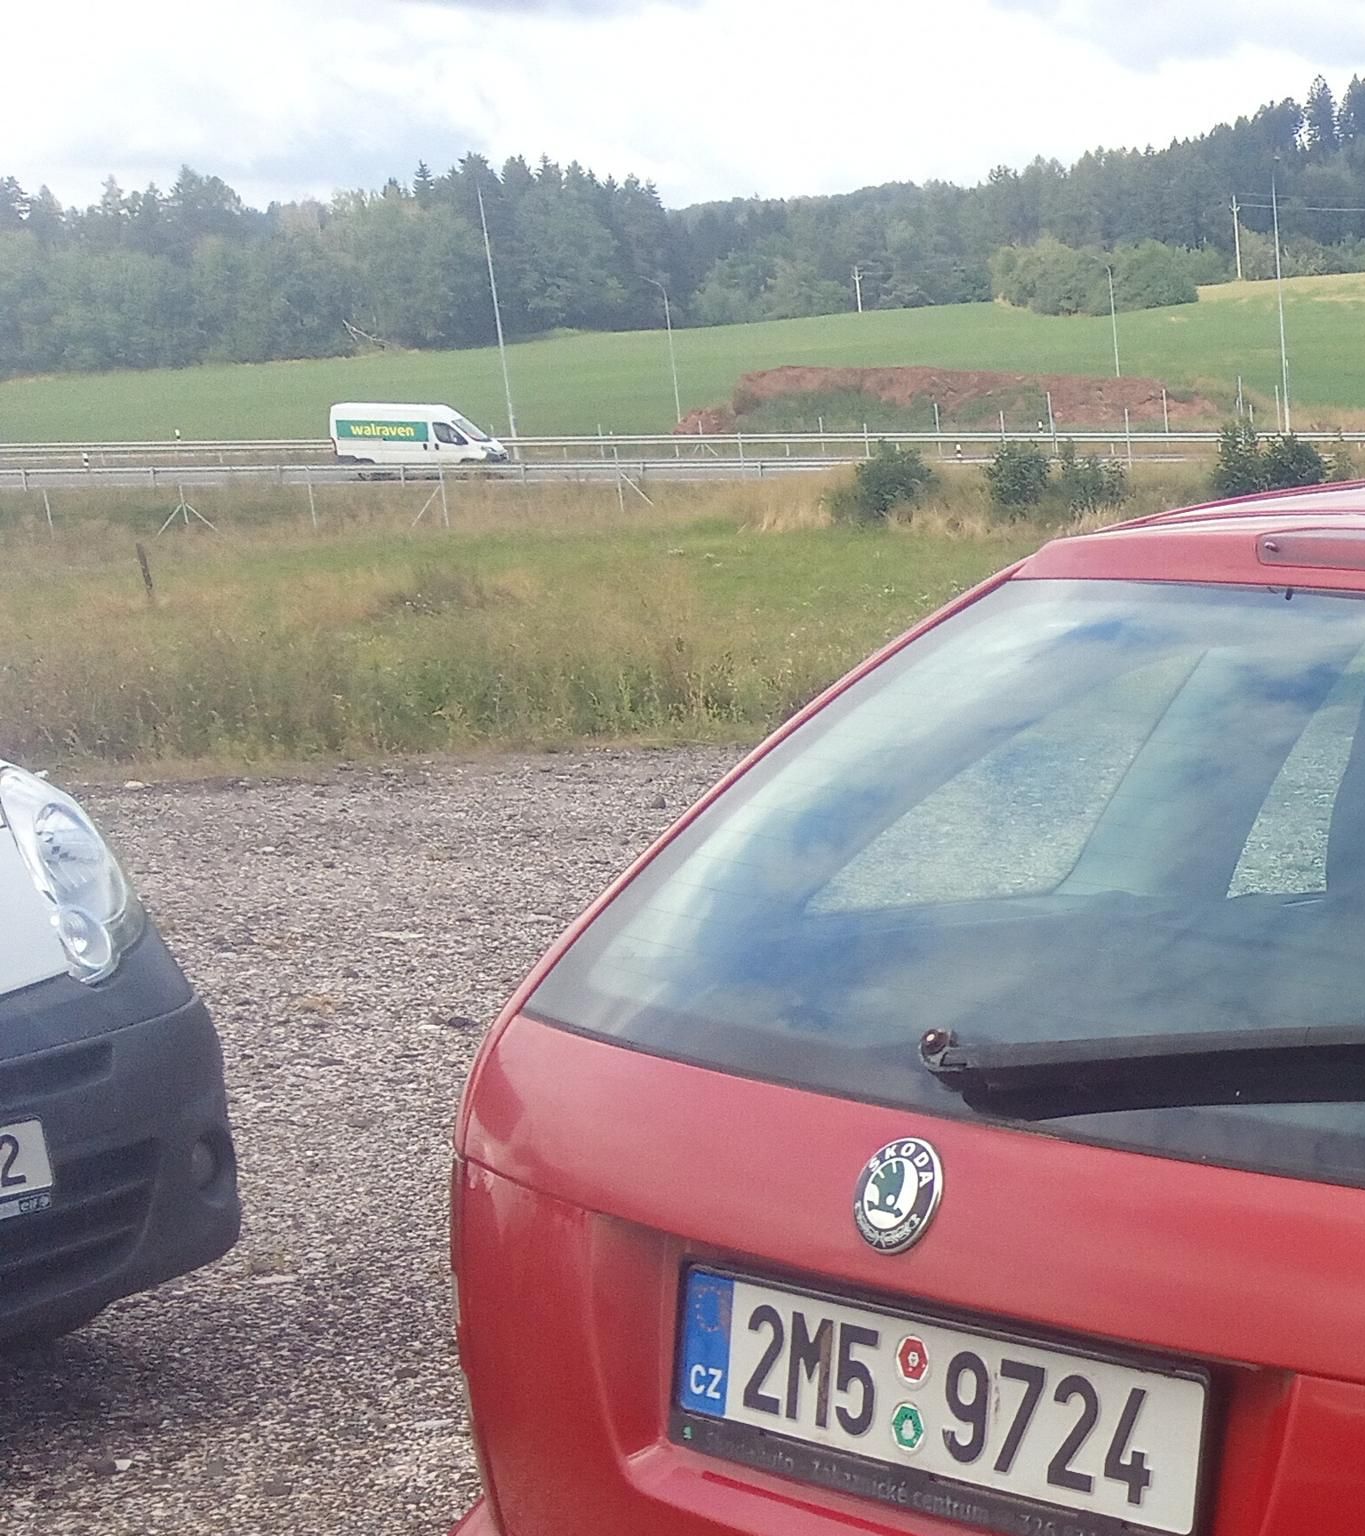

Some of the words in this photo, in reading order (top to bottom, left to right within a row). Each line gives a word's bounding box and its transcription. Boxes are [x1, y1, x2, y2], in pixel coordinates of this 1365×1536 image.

[350, 423, 415, 437] walraven
[688, 1363, 723, 1401] CZ
[742, 1304, 879, 1437] 2M5
[941, 1350, 1152, 1506] 9724
